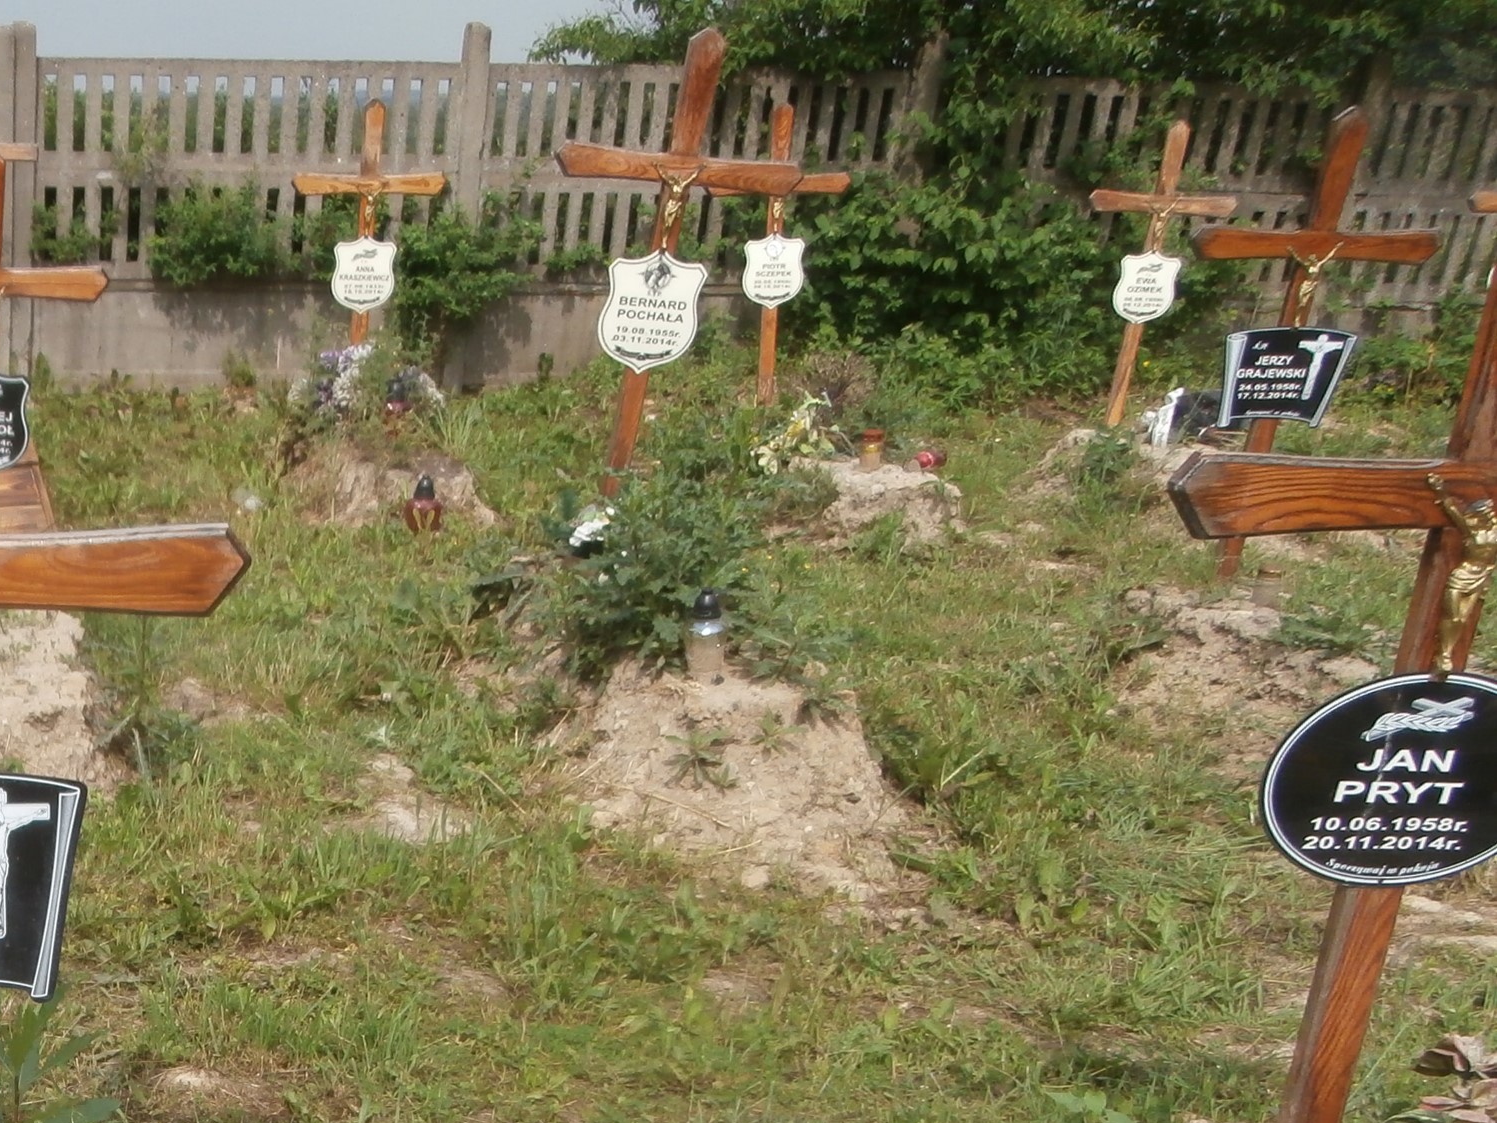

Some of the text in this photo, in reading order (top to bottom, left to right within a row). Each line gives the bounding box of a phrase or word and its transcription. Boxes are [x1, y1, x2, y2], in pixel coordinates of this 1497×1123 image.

[618, 296, 687, 311] BERNARD
[617, 308, 684, 323] POCHAŁA
[612, 334, 679, 347] 03.11.2014r.
[1255, 355, 1294, 366] JERZY
[1236, 368, 1307, 379] GRAJEWSKI
[1237, 391, 1300, 400] 17.12.2014r.
[1356, 749, 1456, 773] JAN
[1333, 781, 1465, 805] PRYT
[1310, 817, 1469, 833] 10.06.1958r.
[1302, 836, 1462, 851] 20.11.2014r.
